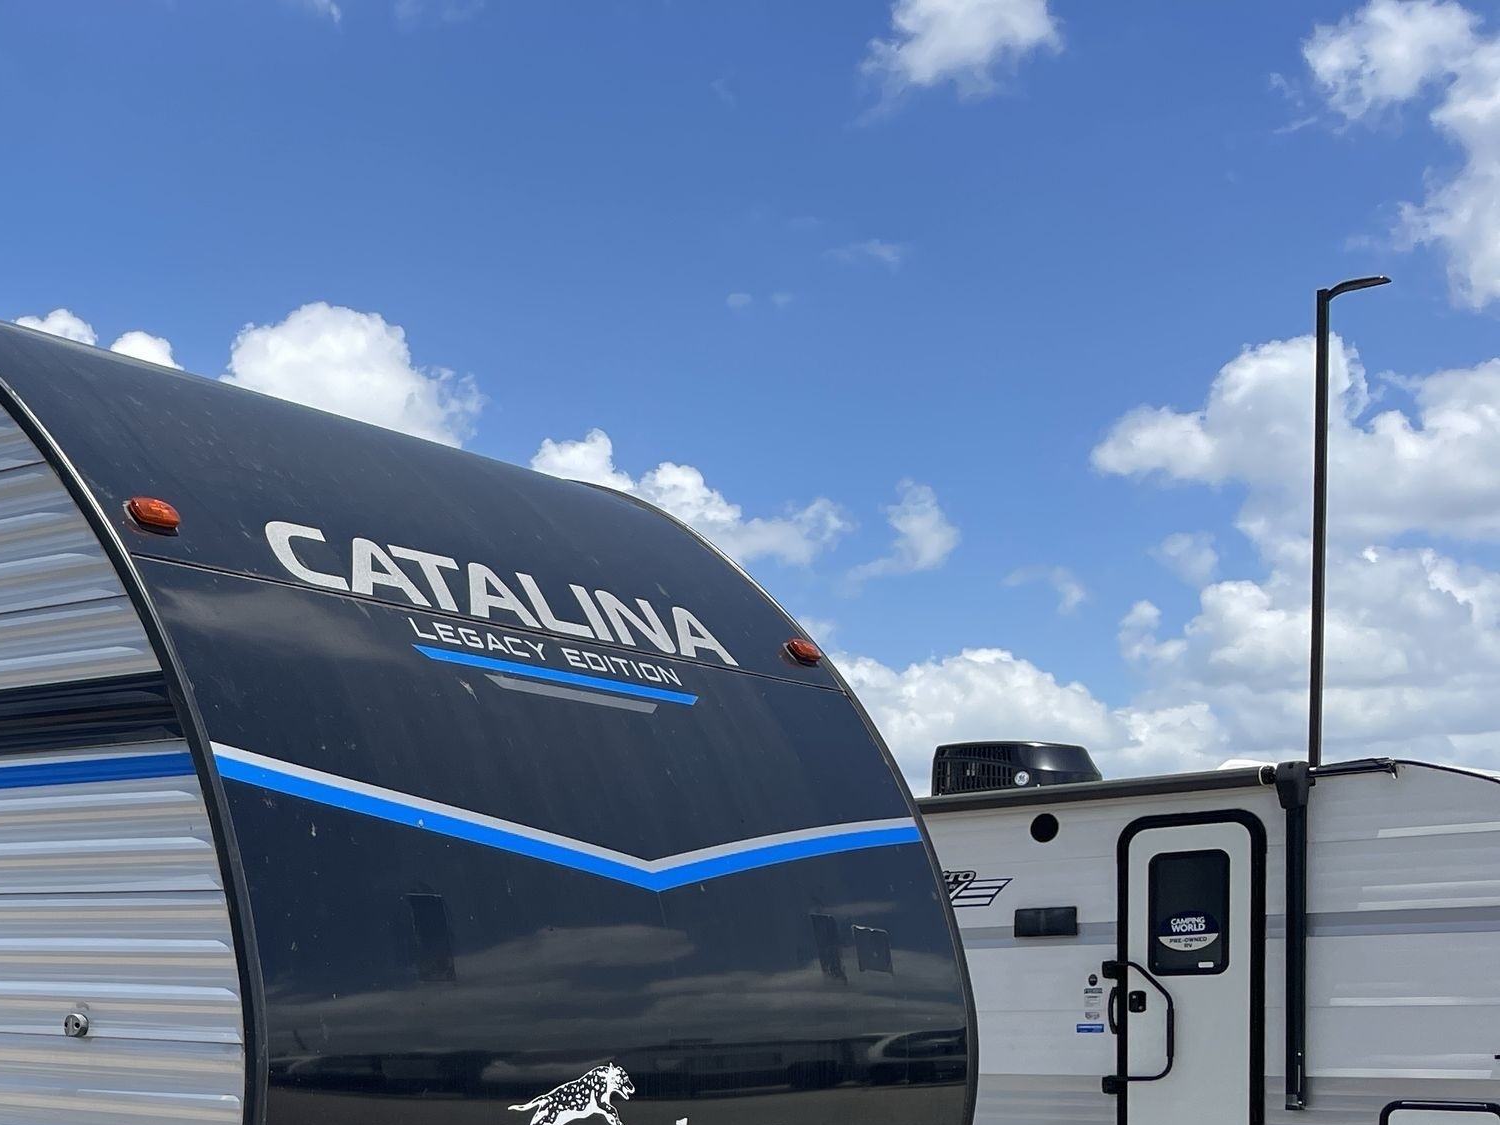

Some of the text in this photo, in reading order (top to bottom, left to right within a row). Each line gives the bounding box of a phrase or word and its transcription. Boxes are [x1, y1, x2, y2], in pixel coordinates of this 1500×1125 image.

[264, 520, 738, 667] CATALINA
[407, 617, 682, 687] LEGACY EDITION
[1171, 923, 1206, 933] WORLD
